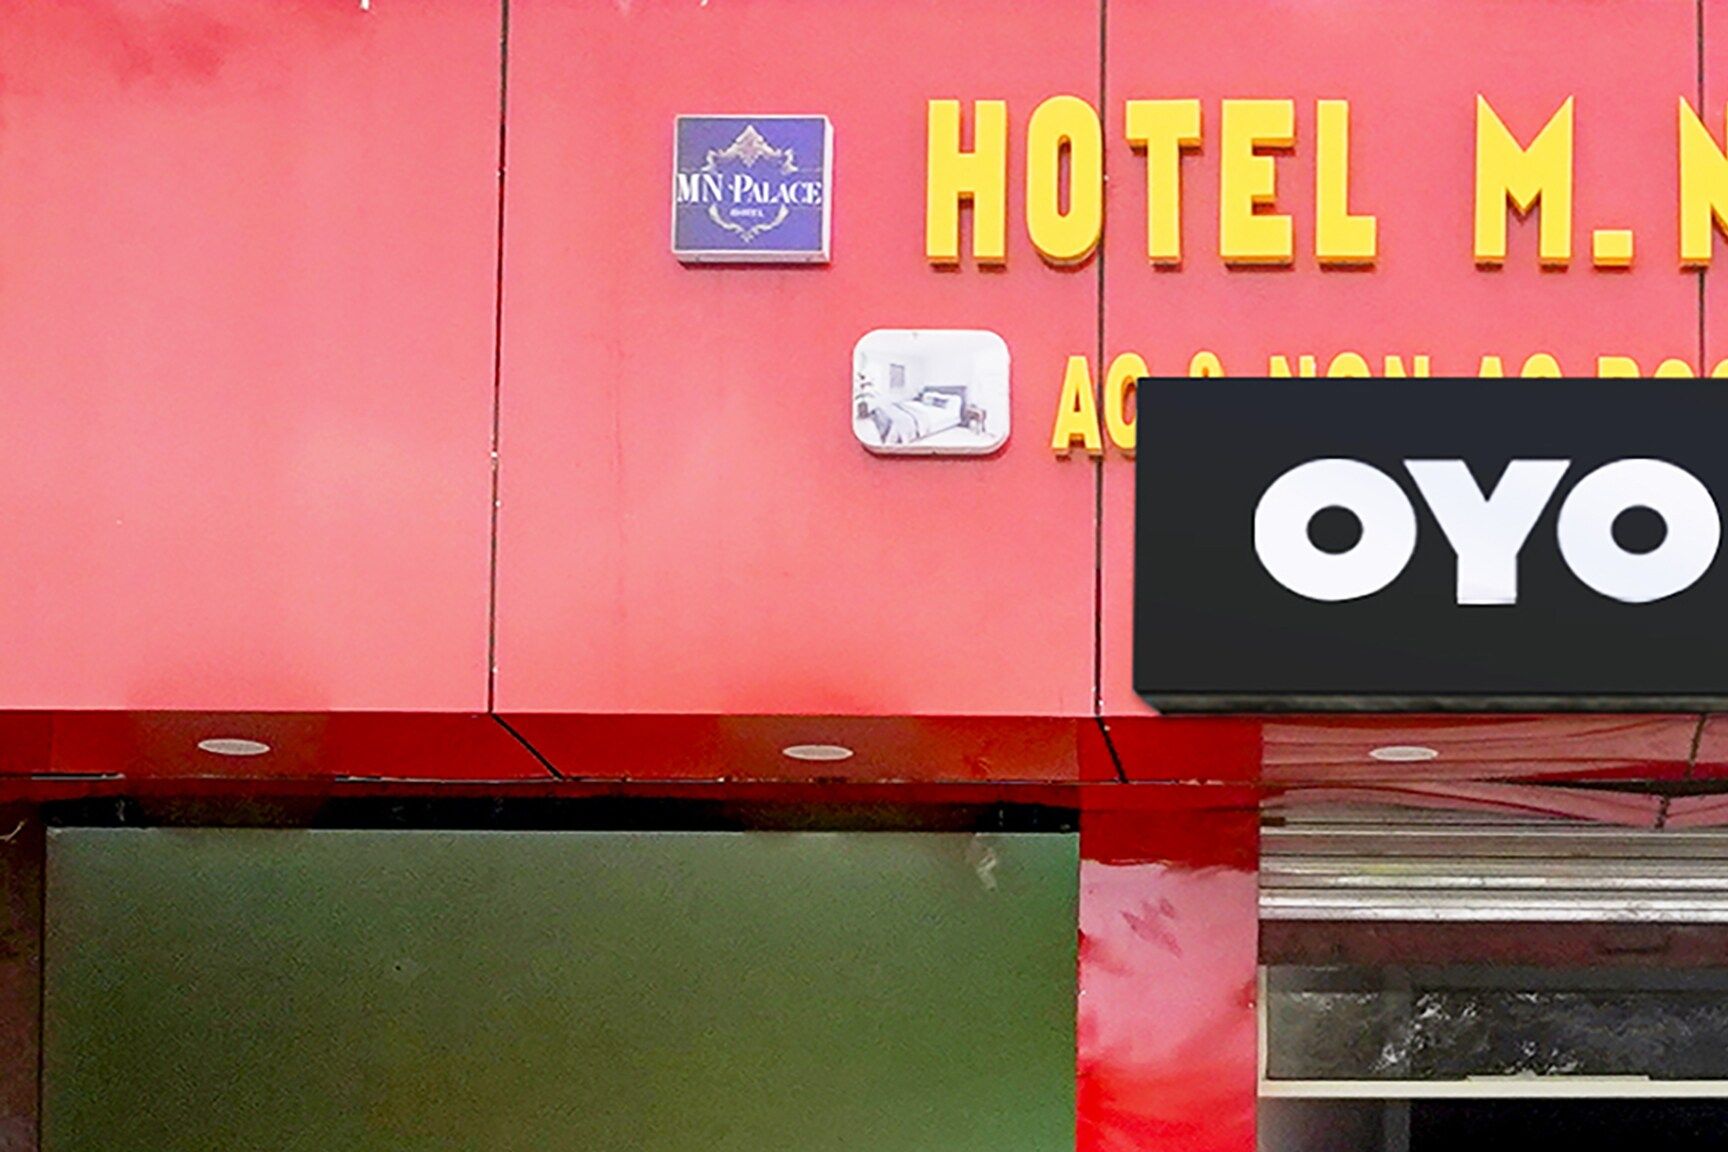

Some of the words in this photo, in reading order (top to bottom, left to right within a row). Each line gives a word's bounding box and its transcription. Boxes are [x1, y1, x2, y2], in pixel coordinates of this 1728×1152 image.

[676, 173, 723, 203] MN
[925, 95, 1378, 267] HOTEL
[1254, 458, 1721, 604] OYO
